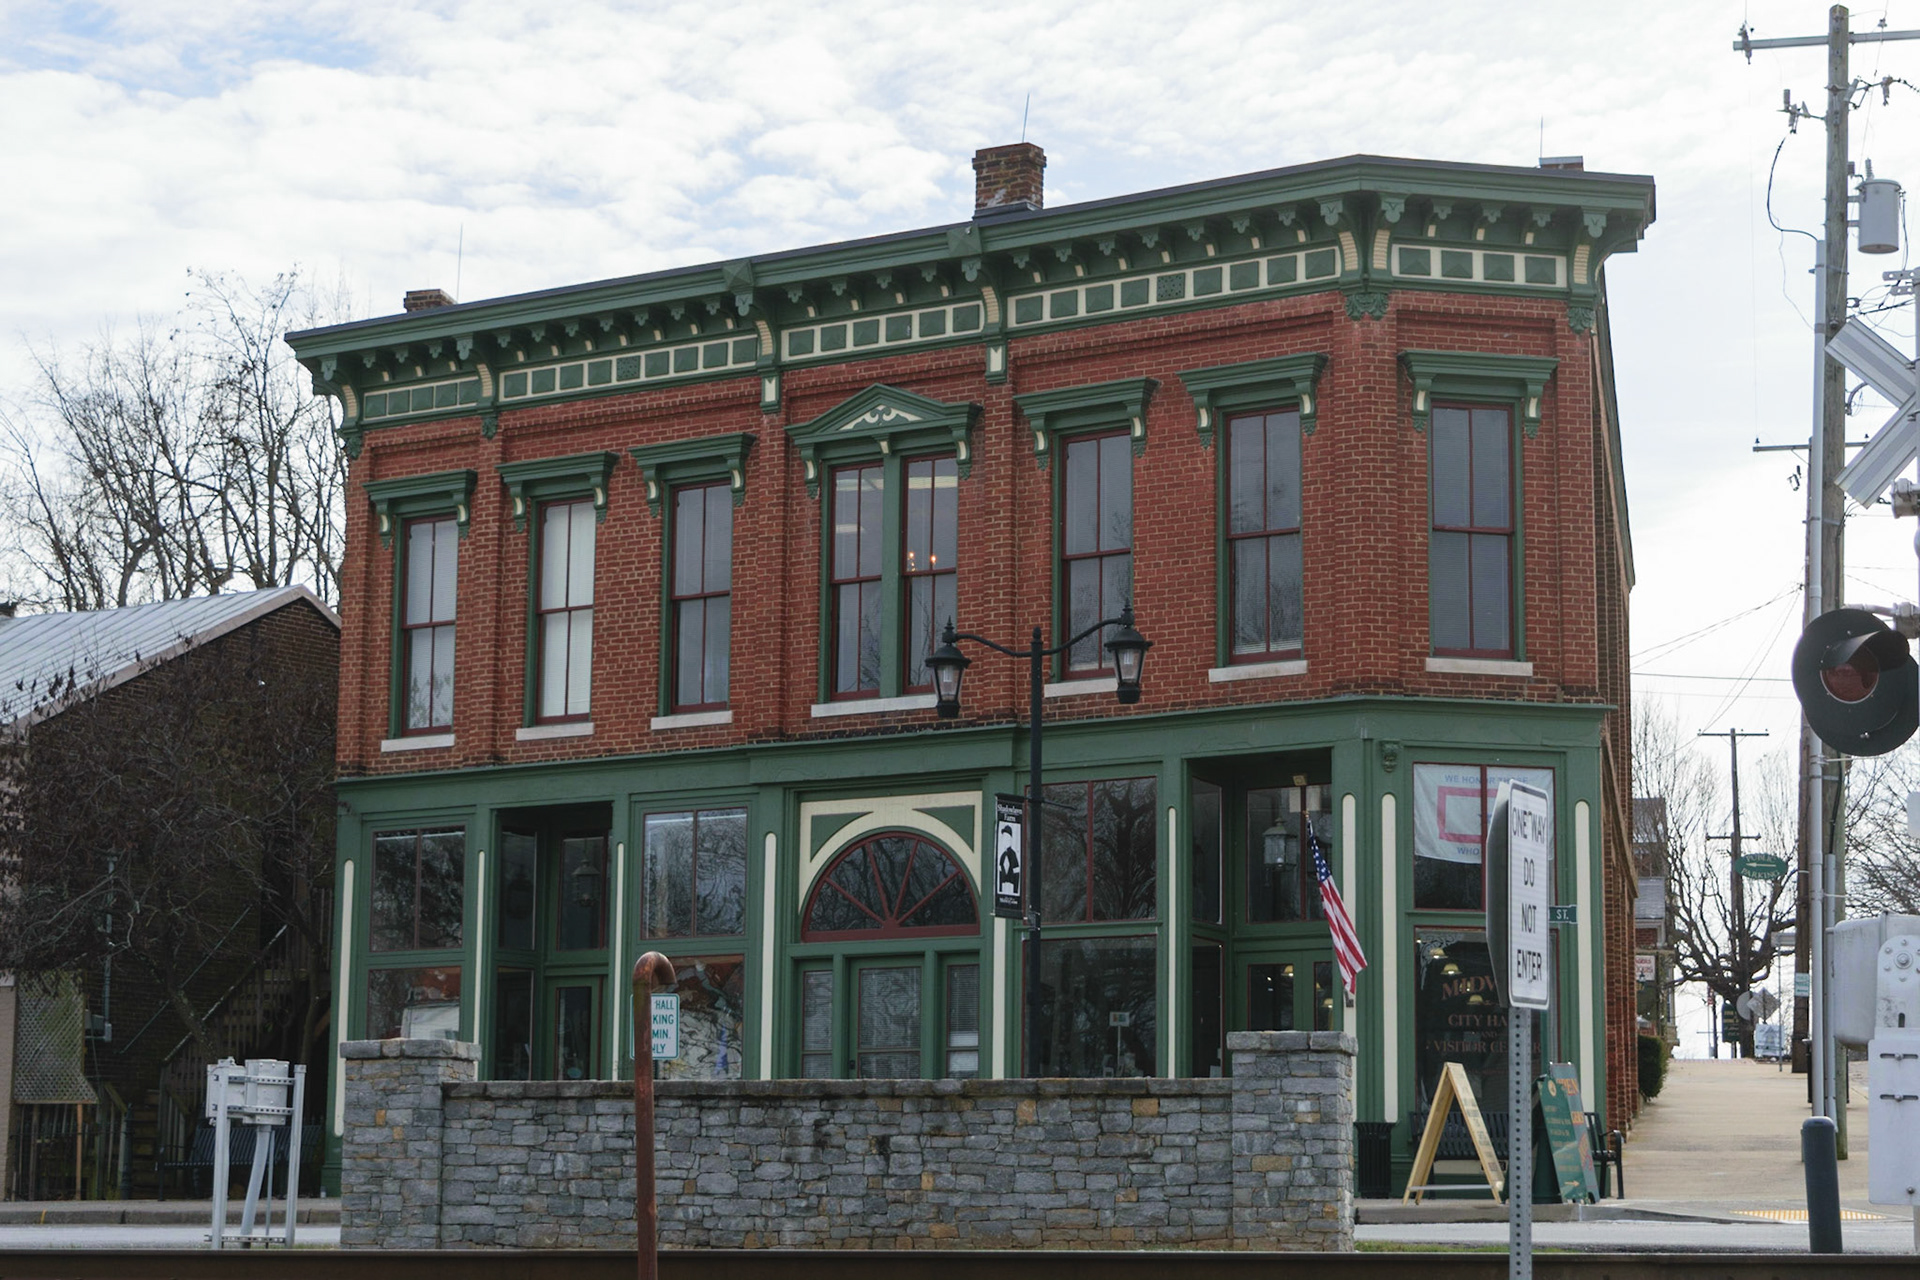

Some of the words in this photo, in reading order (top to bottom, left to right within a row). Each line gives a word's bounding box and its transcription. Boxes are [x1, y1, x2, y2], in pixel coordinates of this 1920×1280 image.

[1445, 774, 1460, 783] WE
[1462, 776, 1495, 784] HONR
[1513, 807, 1528, 839] ONE
[1531, 813, 1547, 844] WAY
[1457, 847, 1480, 855] WHO
[1523, 857, 1535, 887] DO
[1521, 903, 1537, 934] NOT
[1556, 909, 1569, 920] ST.
[1517, 949, 1542, 981] ENTER
[655, 1000, 675, 1010] HALL
[652, 1014, 675, 1024] KING
[1448, 1014, 1483, 1027] CITY
[1487, 1014, 1508, 1027] HA
[652, 1029, 672, 1039] MIN.
[1434, 1041, 1486, 1053] VISITOR
